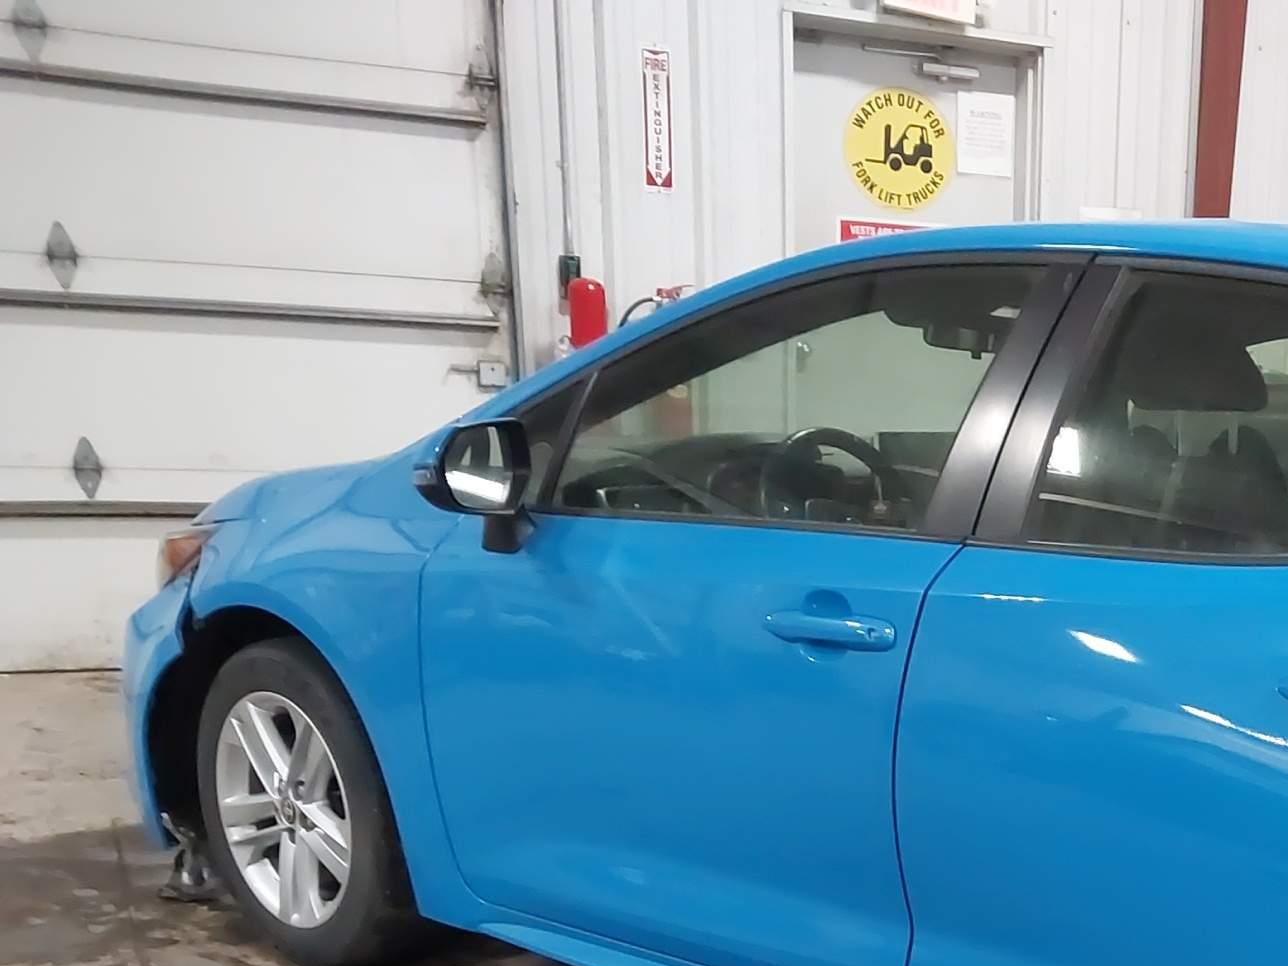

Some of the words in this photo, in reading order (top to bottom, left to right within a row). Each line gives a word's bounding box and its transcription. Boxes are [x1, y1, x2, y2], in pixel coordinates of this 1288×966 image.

[645, 57, 667, 71] FIRE
[652, 73, 663, 179] EXTINGUISHER
[852, 93, 893, 129] WATCH
[897, 93, 924, 113] OUT
[923, 110, 945, 138] FOR
[852, 161, 877, 194] FORK
[878, 188, 902, 206] LIFT
[906, 171, 944, 206] TRUCKS
[849, 224, 876, 236] VESTS
